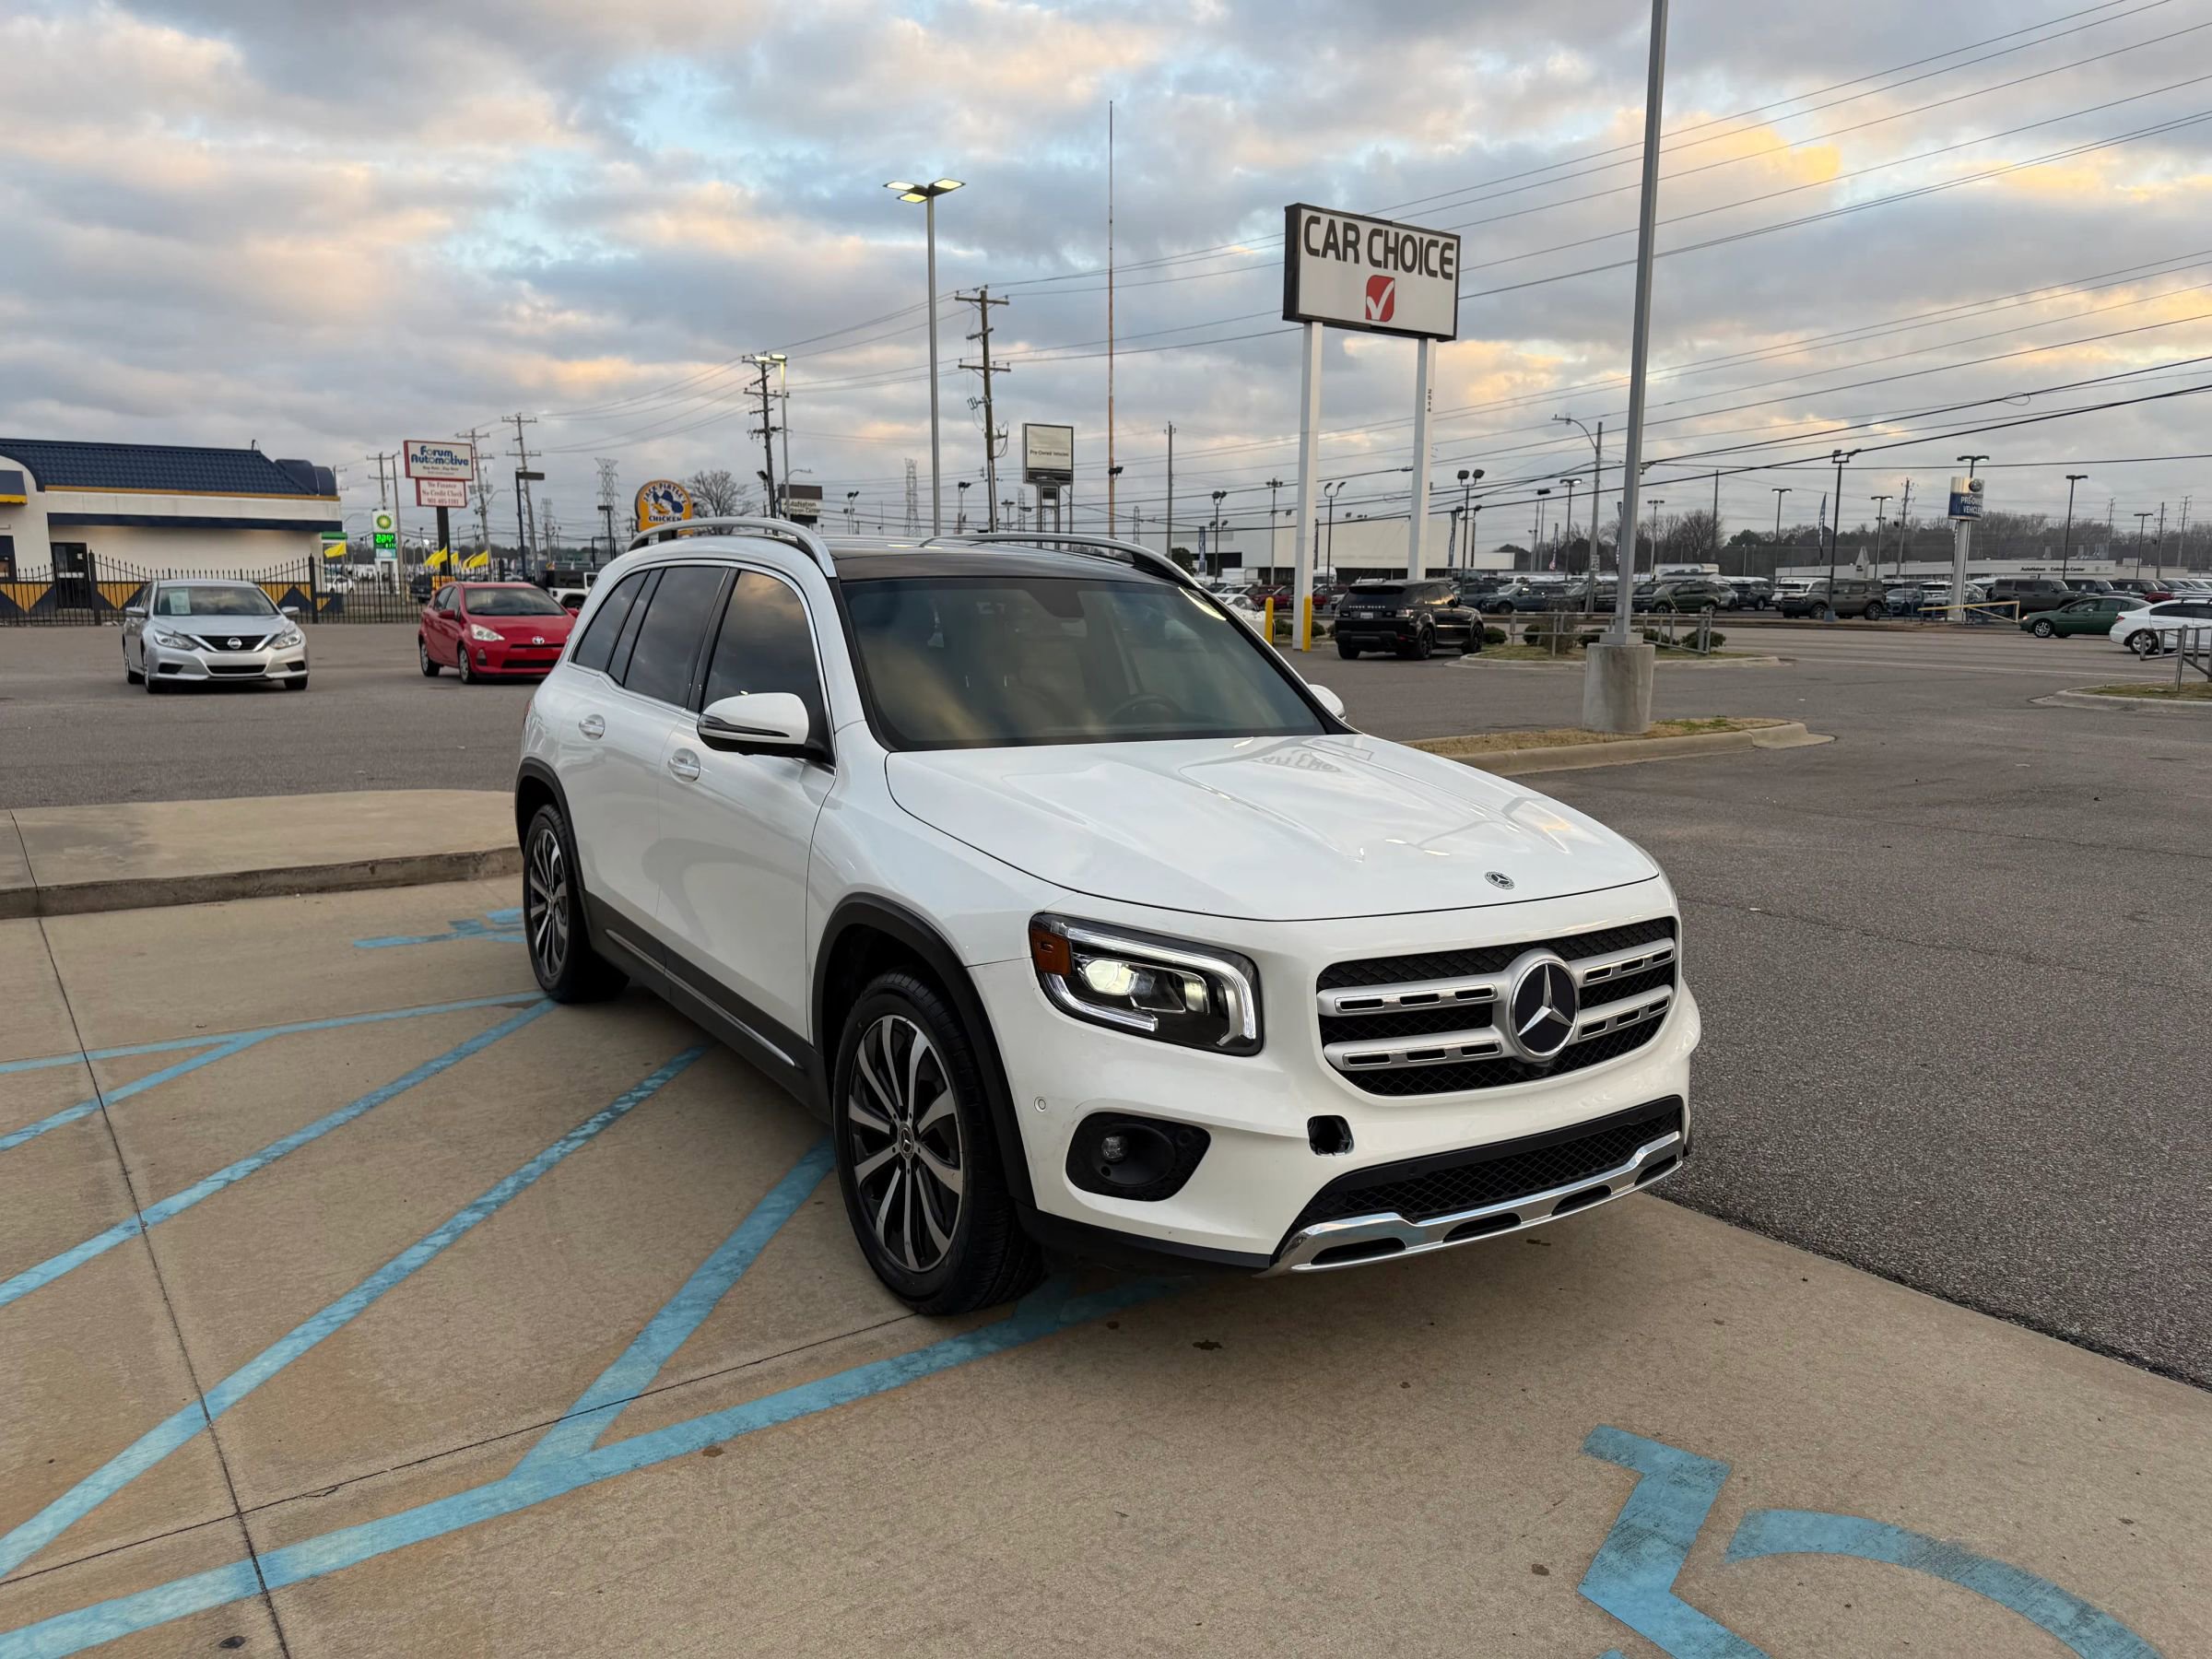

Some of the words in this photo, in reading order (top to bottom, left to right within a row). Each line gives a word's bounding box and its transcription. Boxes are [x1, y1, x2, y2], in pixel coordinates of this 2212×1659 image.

[1303, 215, 1360, 265] CAR
[1367, 228, 1454, 281] CHOICE
[420, 445, 453, 457] Forum
[411, 453, 469, 465] Automotive
[643, 485, 657, 502] JACK
